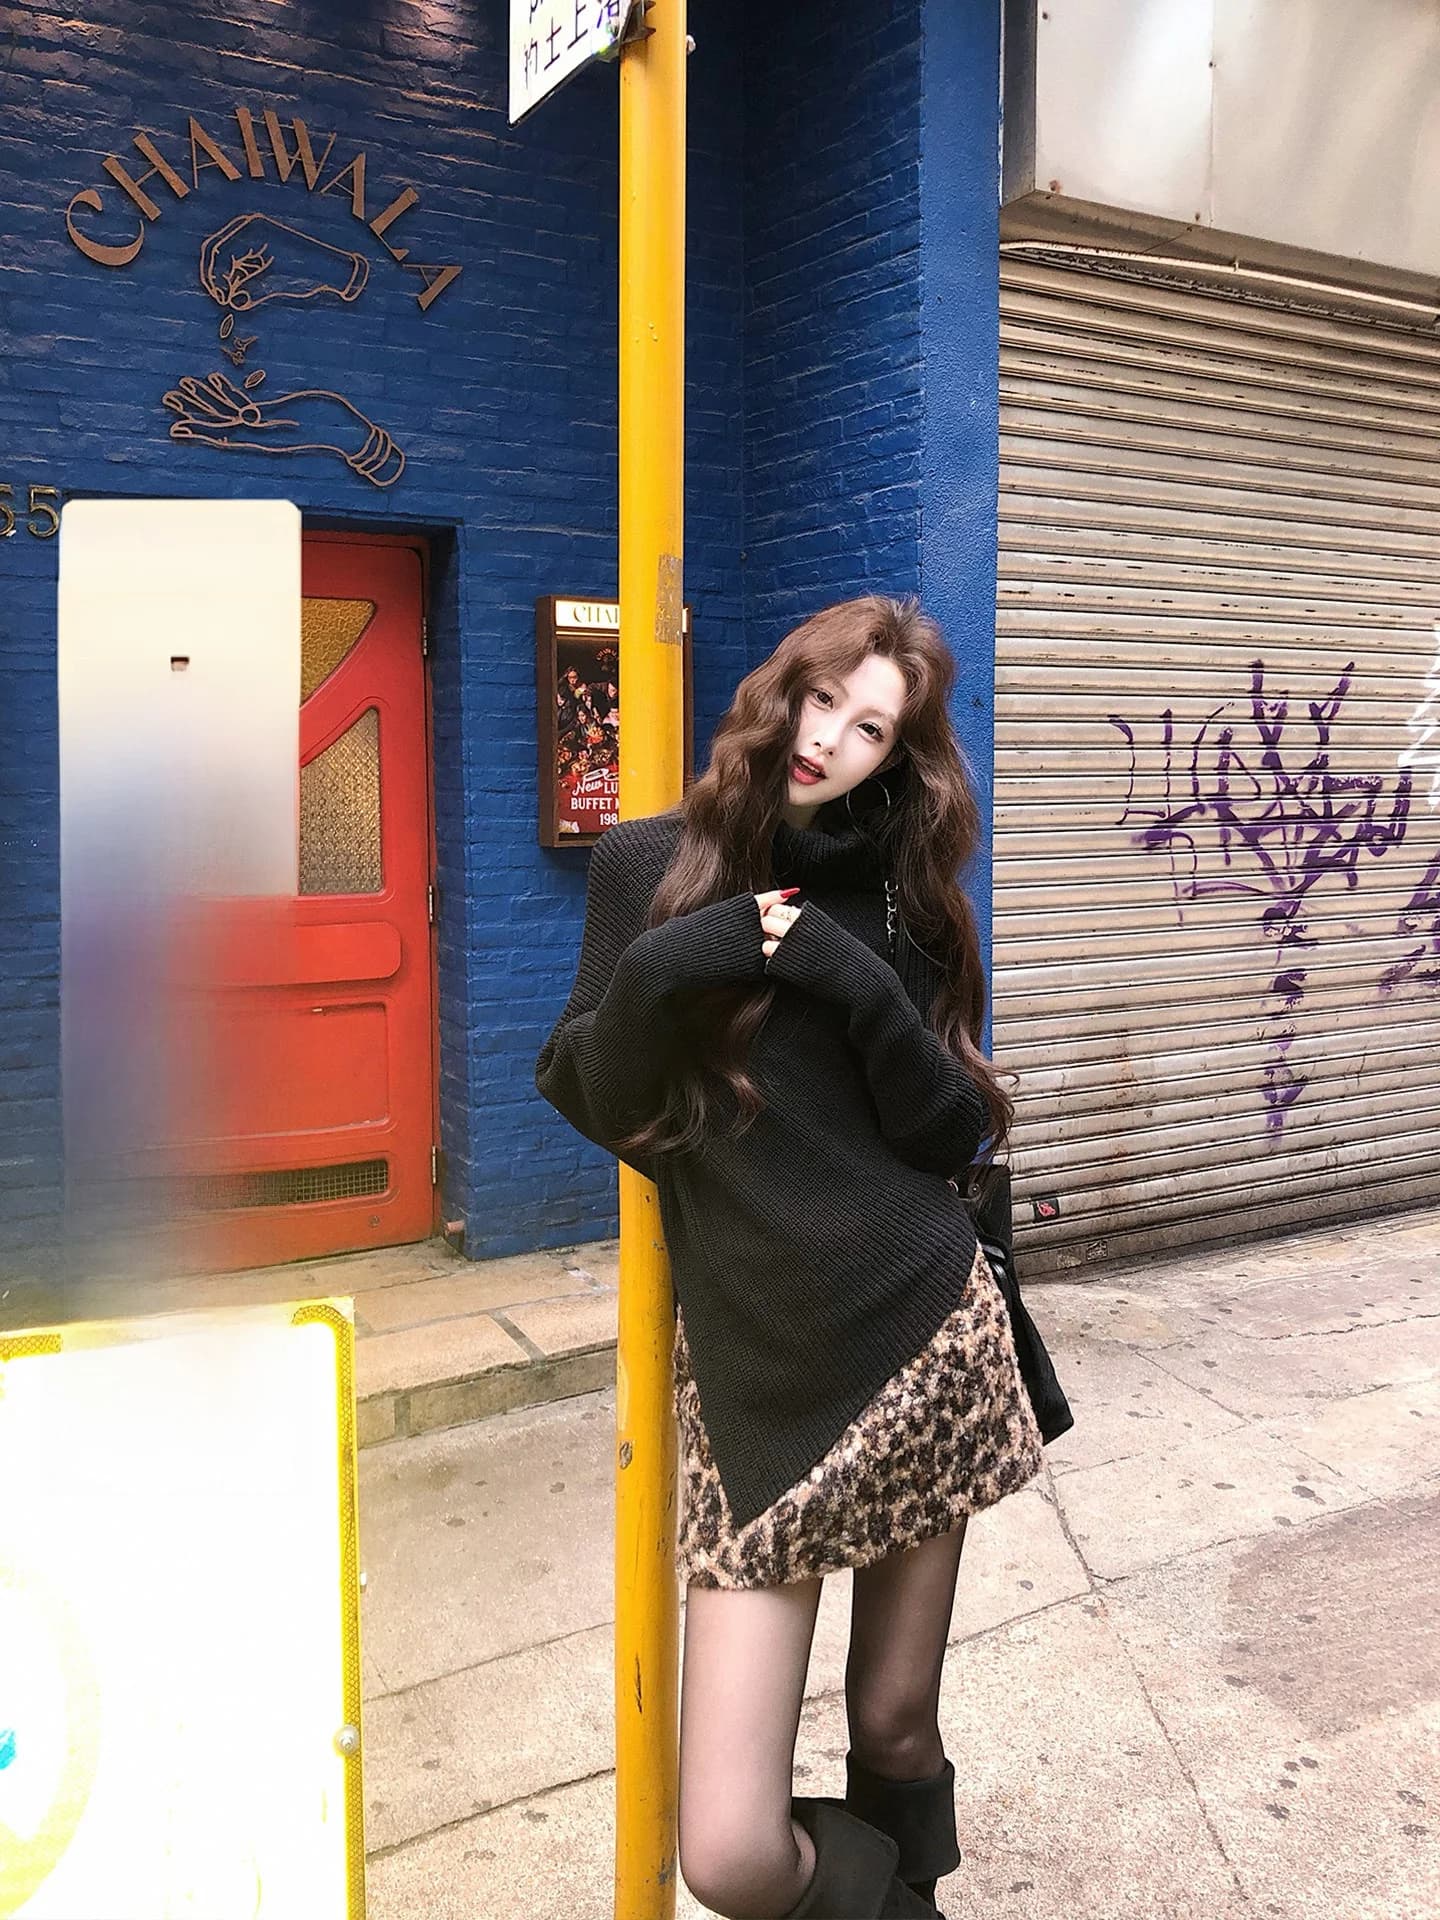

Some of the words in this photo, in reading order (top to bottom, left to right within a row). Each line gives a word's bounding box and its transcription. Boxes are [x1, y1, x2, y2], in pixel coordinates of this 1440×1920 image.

[66, 107, 462, 311] CHAIWALA
[571, 773, 603, 796] New
[571, 797, 613, 810] BUFFET
[599, 812, 618, 826] 198
